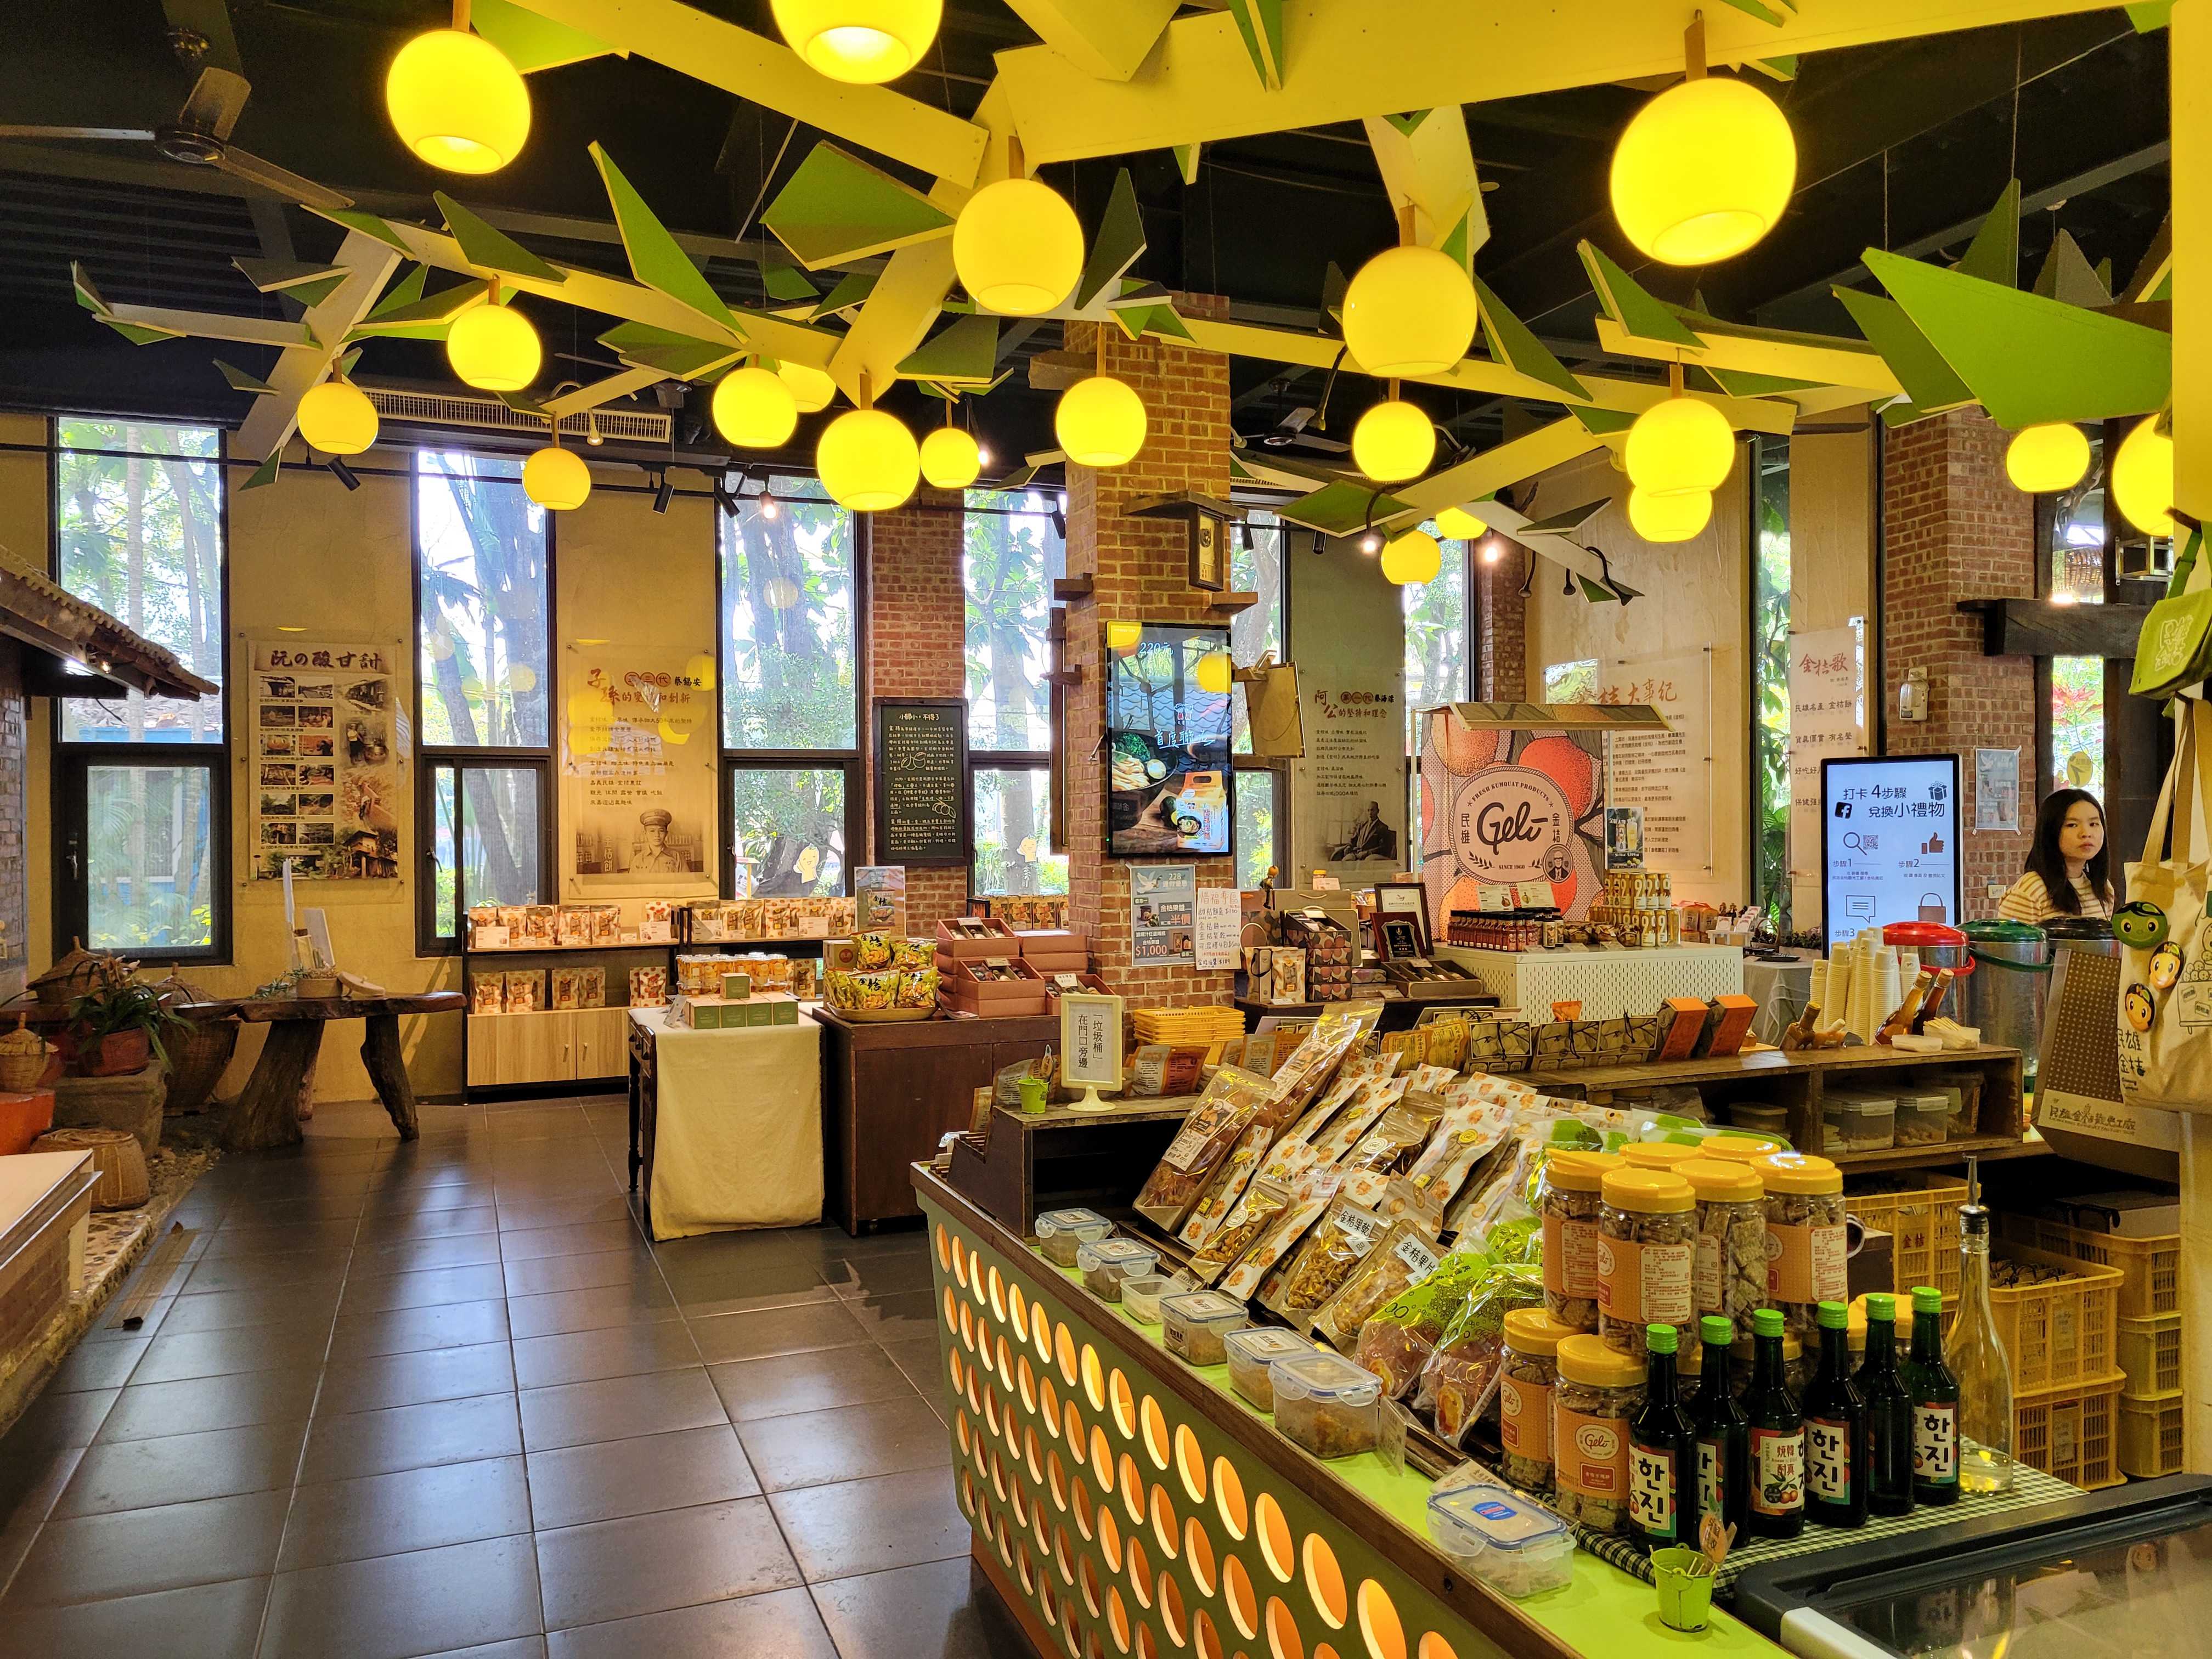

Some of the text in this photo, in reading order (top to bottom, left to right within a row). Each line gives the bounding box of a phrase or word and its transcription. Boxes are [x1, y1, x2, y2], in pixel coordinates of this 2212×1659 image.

[1139, 642, 1173, 655] 220元
[1798, 652, 1848, 677] 金桔歌
[1795, 700, 1852, 713] 民雄名產 金桔餅
[1471, 781, 1550, 802] FRESH KUMQUAT PRODUCTS
[1868, 803, 1945, 818] 兌換小禮物
[1461, 813, 1470, 844] 民雄
[1552, 812, 1561, 843] 金桔
[1833, 859, 1852, 867] 步驟1
[1898, 859, 1920, 868] 步驟2
[1835, 928, 1855, 937] 步驟3
[1135, 945, 1167, 957] $1,000
[1078, 1014, 1088, 1068] 在門口旁邊
[1092, 1014, 1103, 1059] 「垃圾桶」
[1340, 1210, 1371, 1237] 金桔果乾
[1902, 1233, 1925, 1250] 金桔
[1401, 1241, 1436, 1276] 金桔果片
[1924, 1414, 1950, 1472] 한진
[1812, 1429, 1840, 1492] 한진
[1638, 1457, 1665, 1524] 한진
